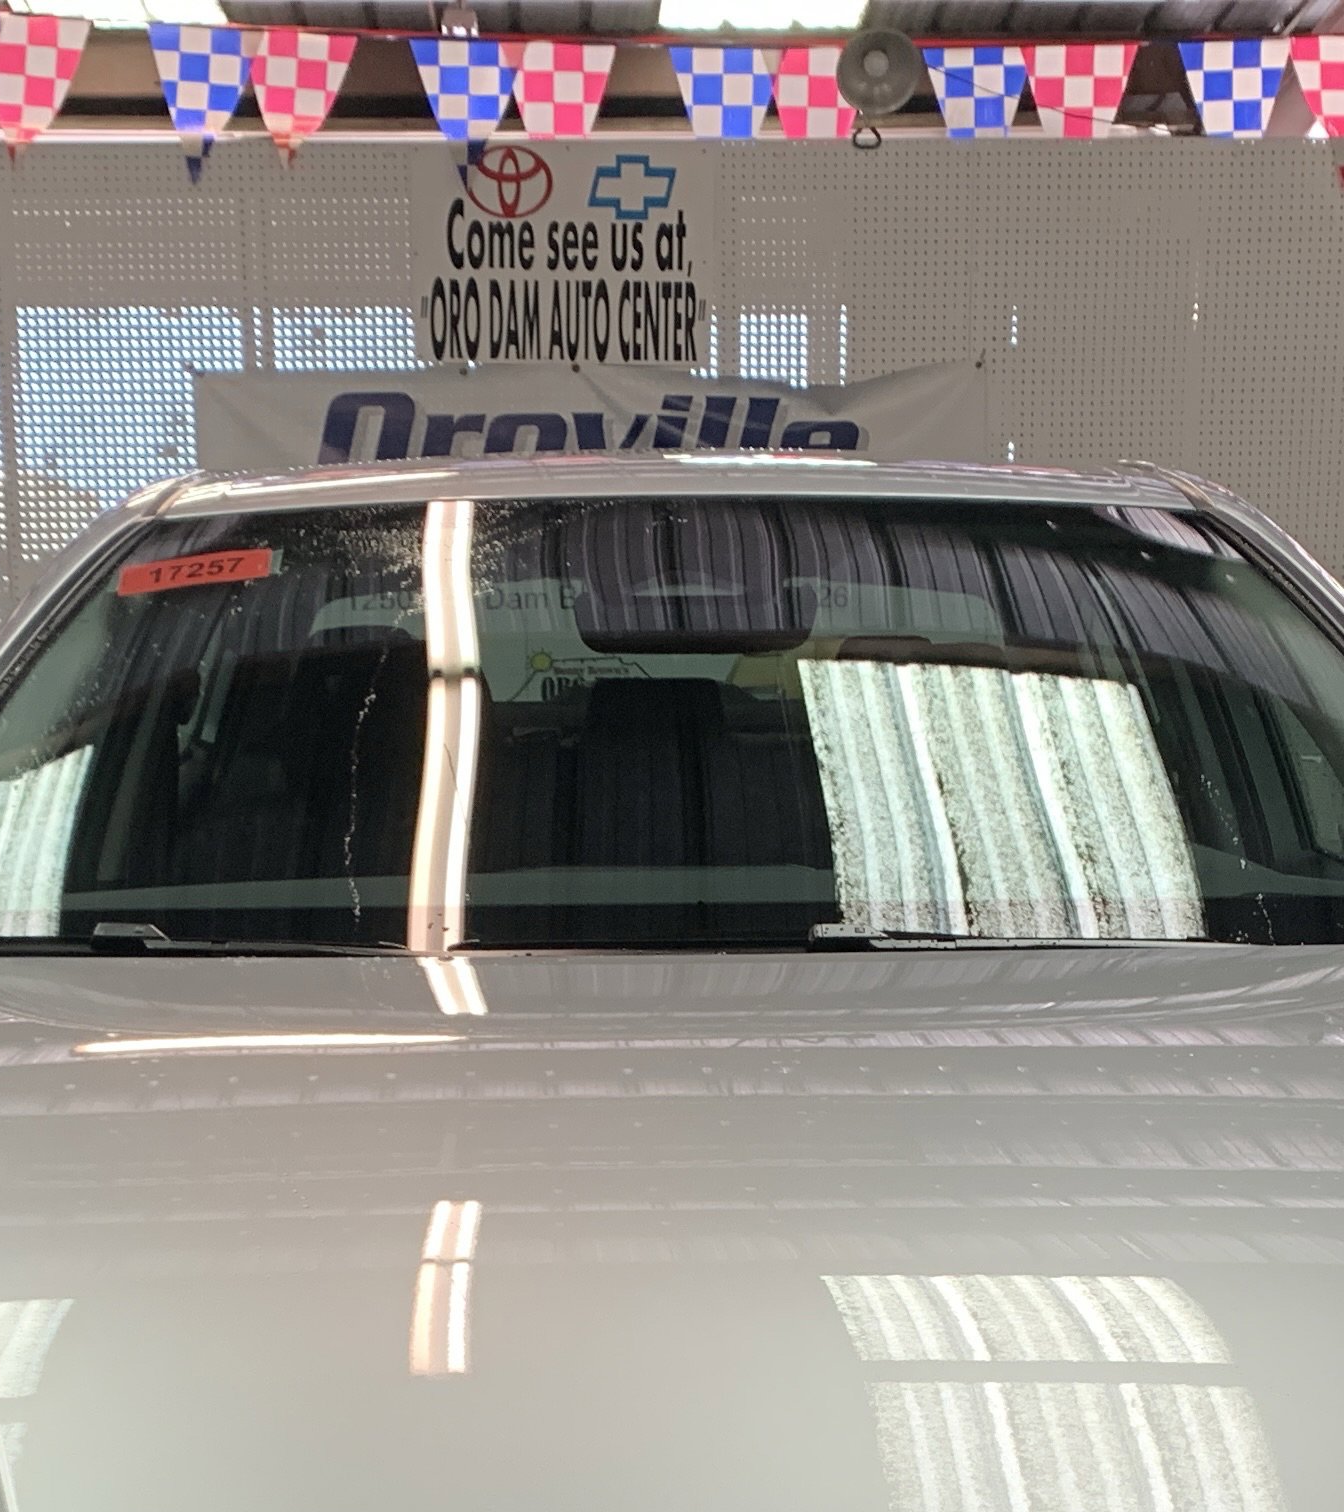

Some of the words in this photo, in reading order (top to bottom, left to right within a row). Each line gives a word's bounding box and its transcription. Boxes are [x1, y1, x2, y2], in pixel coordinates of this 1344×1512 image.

[447, 198, 535, 270] Come
[547, 221, 599, 271] see
[611, 222, 644, 271] us
[489, 279, 541, 360] DAM
[550, 278, 610, 361] AUTO
[318, 391, 861, 464] Oroville
[149, 556, 245, 584] 17257
